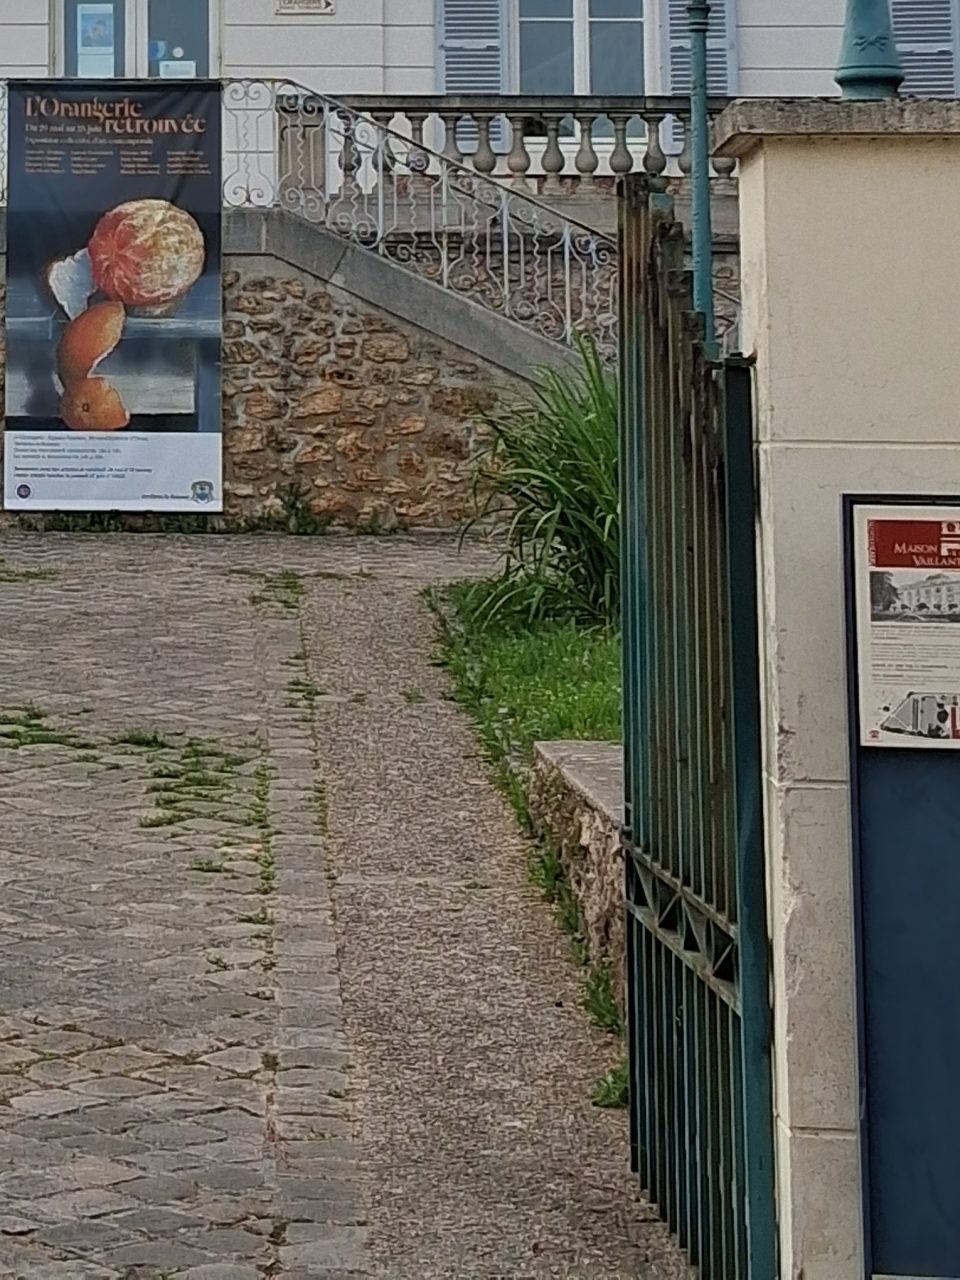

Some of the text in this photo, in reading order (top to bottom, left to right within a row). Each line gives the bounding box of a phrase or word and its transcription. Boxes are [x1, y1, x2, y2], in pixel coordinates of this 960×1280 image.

[25, 95, 143, 123] L'Orangerie
[105, 113, 207, 134] retrouvée
[893, 541, 938, 554] MAISON
